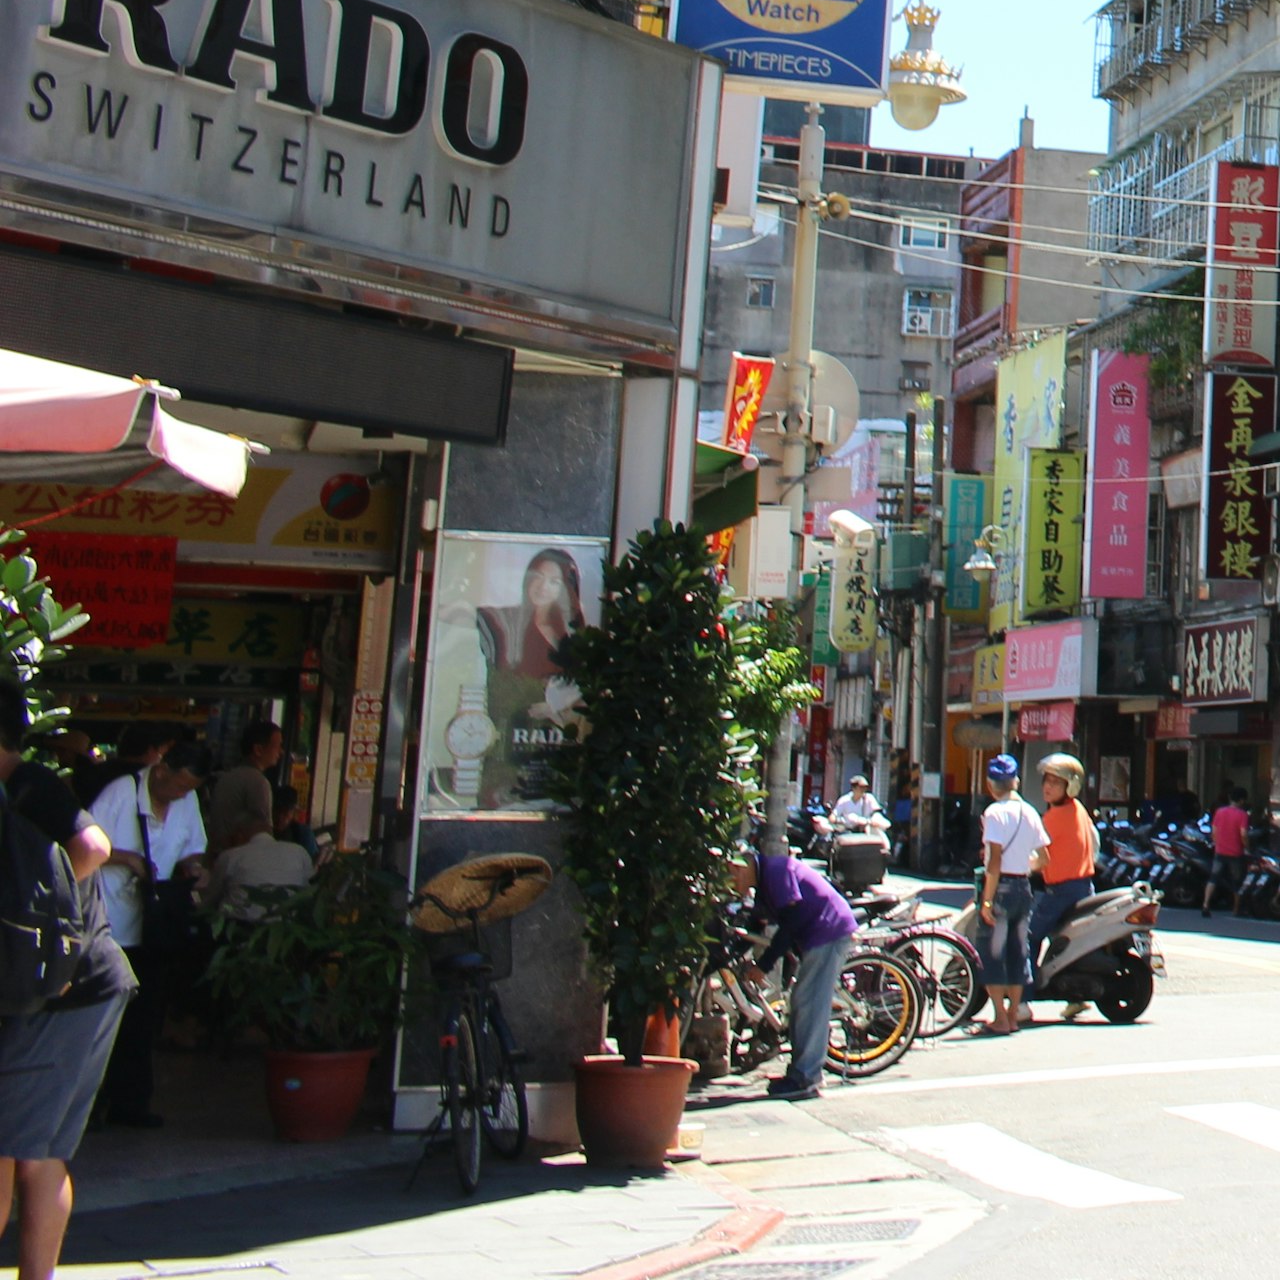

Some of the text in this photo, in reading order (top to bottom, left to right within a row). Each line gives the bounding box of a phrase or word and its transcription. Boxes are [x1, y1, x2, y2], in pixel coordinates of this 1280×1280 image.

[724, 46, 833, 80] TIMEPIECES
[27, 71, 514, 240] SWITZERLAND
[1039, 458, 1065, 606] 秀家自助餐
[1108, 423, 1132, 547] 義美食品
[1218, 376, 1264, 580] 金再泉銀樓
[1183, 623, 1256, 699] 金再泉銀樓
[512, 727, 564, 745] RAD
